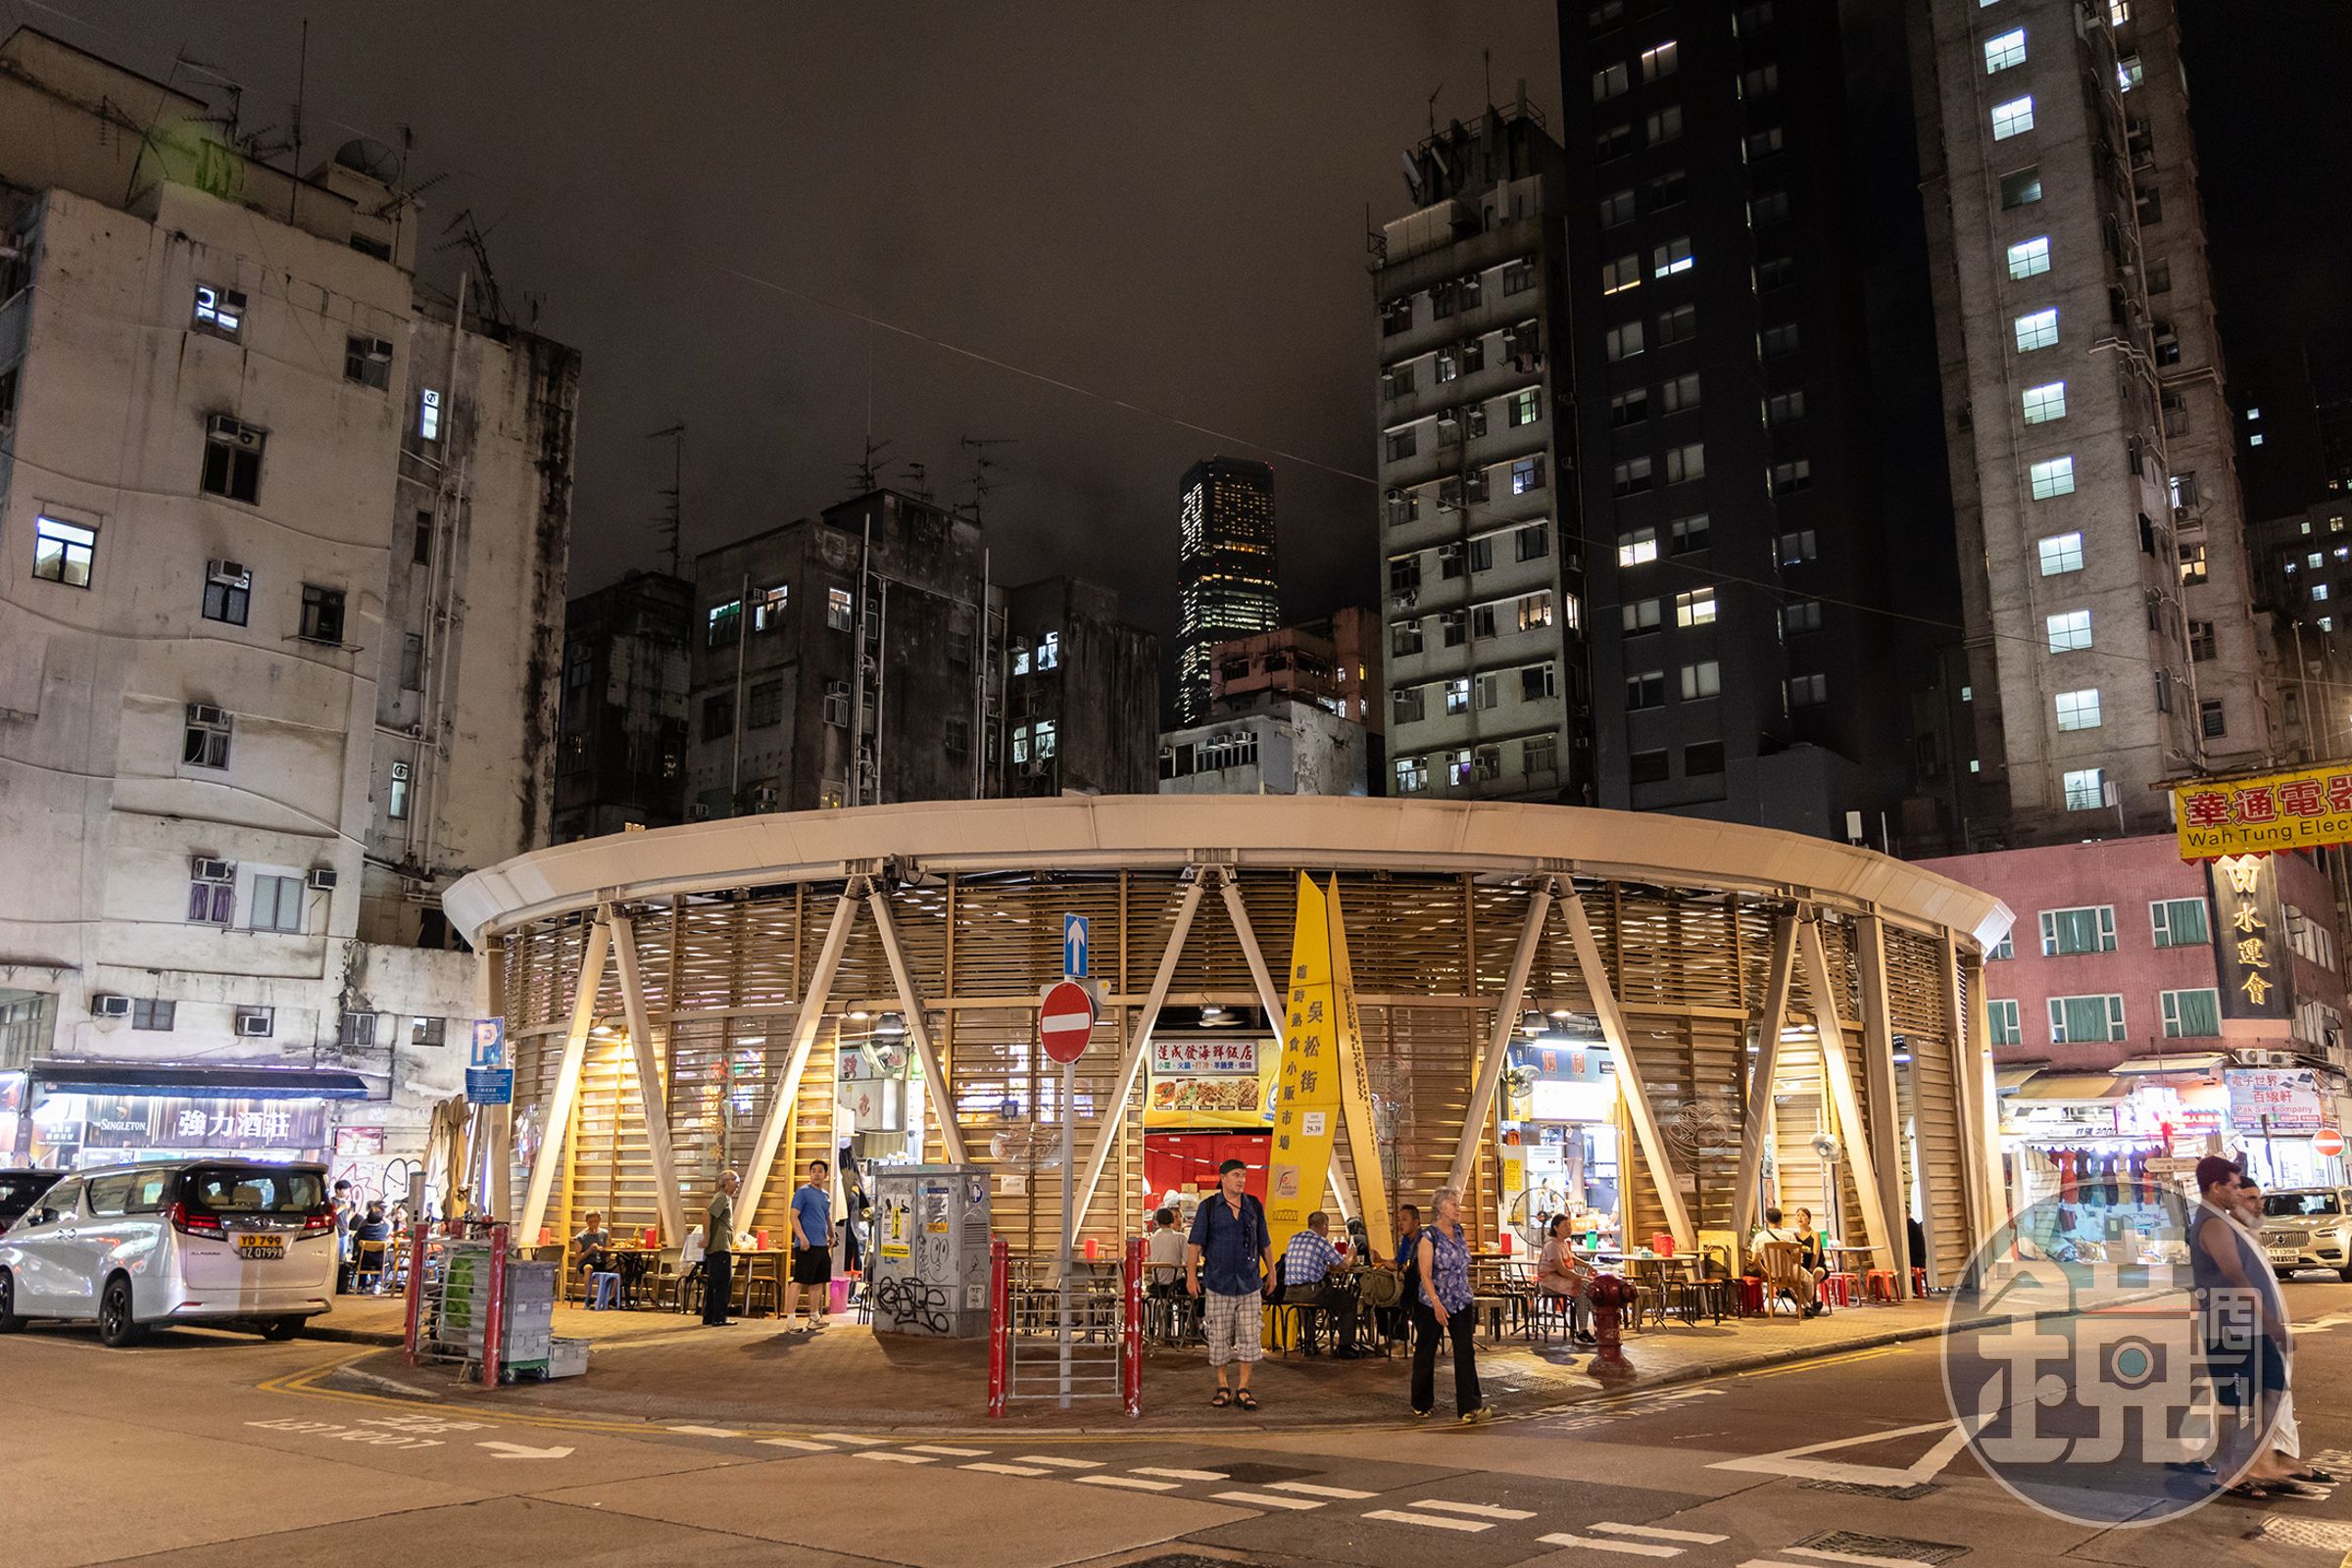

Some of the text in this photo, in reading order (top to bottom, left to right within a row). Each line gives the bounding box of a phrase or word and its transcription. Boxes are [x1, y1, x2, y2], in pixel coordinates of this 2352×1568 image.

[2187, 817, 2352, 847] Wah Tung Elec
[2233, 902, 2274, 1005] 水運會
[476, 1023, 498, 1061] P
[101, 1118, 146, 1131] SINGLETON
[178, 1109, 291, 1138] 強力酒莊
[241, 1236, 281, 1246] YD 799
